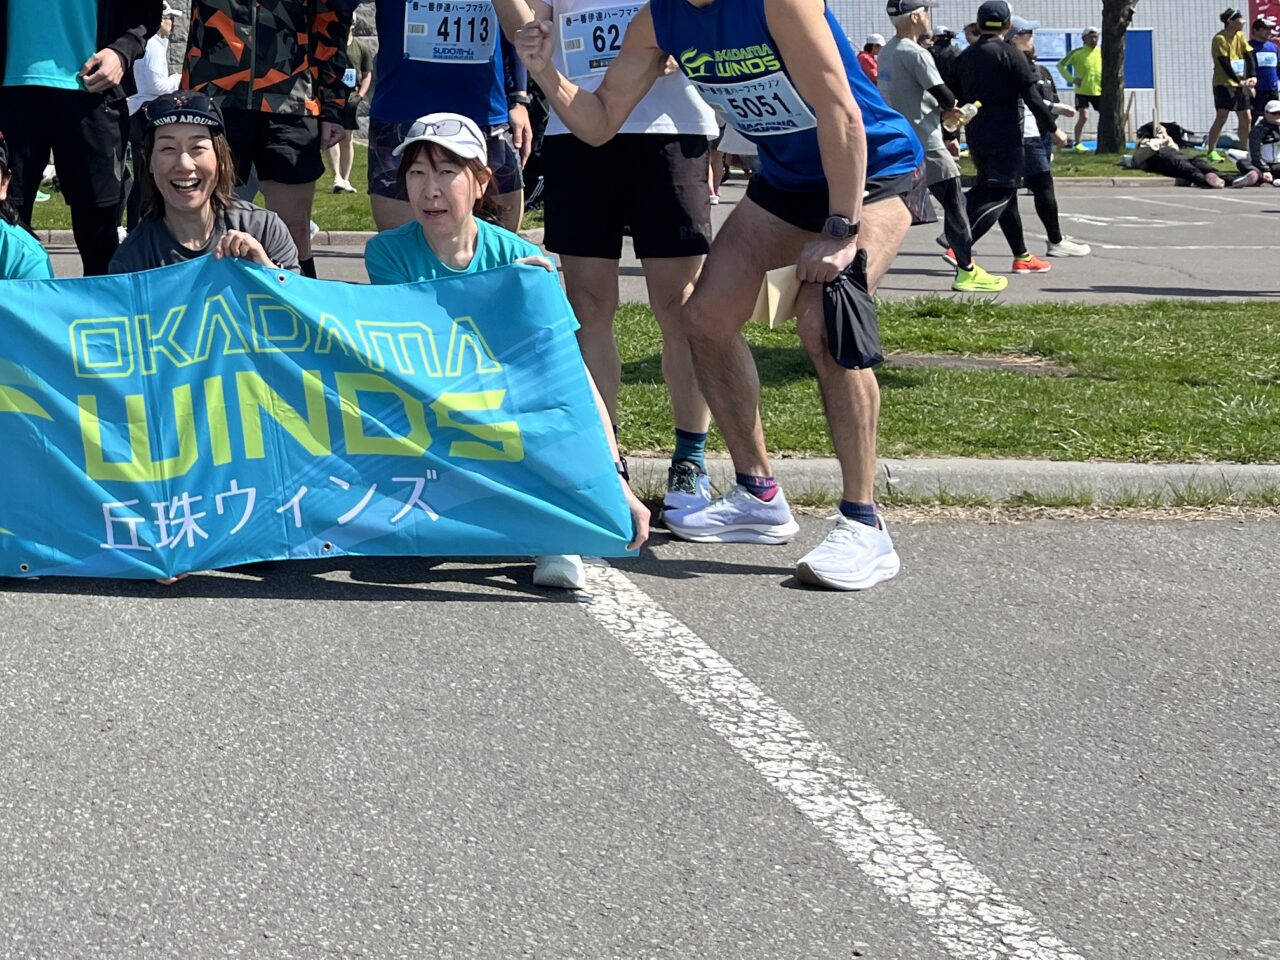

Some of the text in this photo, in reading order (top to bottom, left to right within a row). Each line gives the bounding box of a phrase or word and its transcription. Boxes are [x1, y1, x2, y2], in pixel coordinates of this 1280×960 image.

[437, 16, 489, 42] 4113
[153, 115, 177, 126] JUMP
[727, 92, 792, 119] 5051
[68, 294, 503, 378] OKADAMA
[77, 371, 525, 482] WINDS
[100, 469, 440, 552] 丘珠ウィンズ
